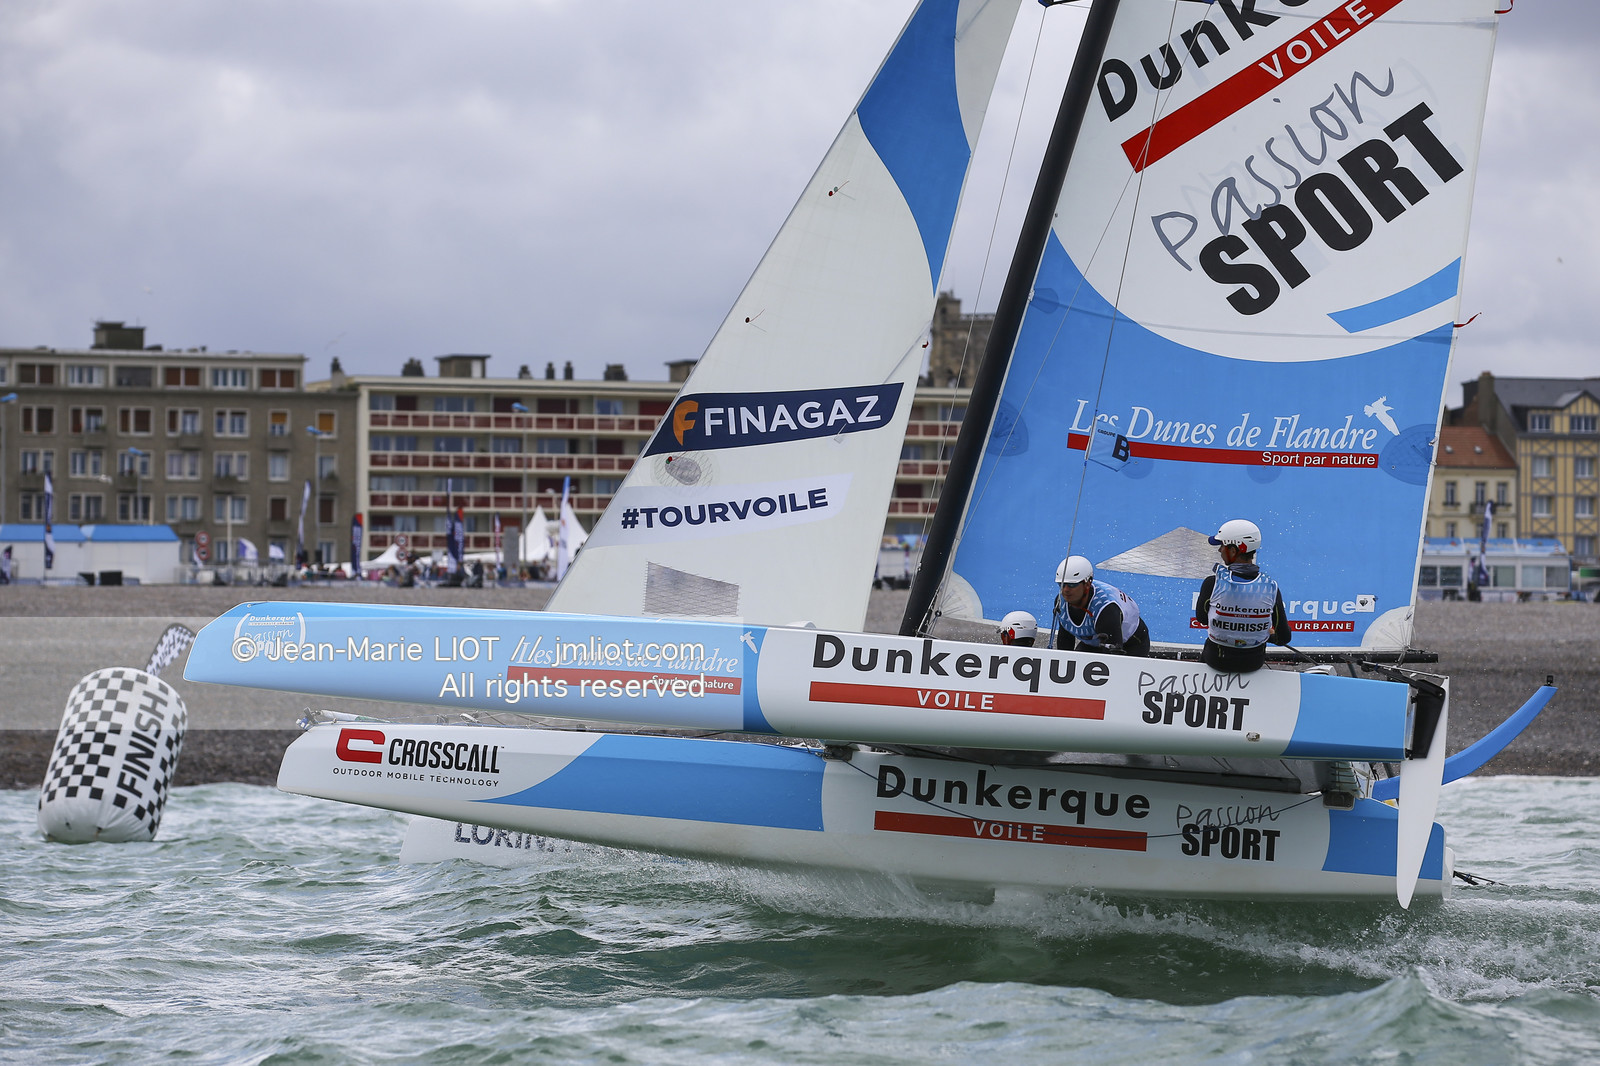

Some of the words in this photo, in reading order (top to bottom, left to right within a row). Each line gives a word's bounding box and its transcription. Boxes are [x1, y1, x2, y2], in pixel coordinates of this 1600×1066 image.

[1258, 0, 1374, 80] VOILE
[1097, 0, 1309, 122] Dunk
[1199, 101, 1465, 315] SPORT
[704, 395, 881, 436] FINAGAZ
[1126, 406, 1217, 445] Dunes
[1226, 413, 1261, 448] de
[1265, 413, 1378, 449] Flandre
[1112, 433, 1129, 462] B
[1262, 451, 1300, 466] Sport
[1304, 455, 1327, 467] par
[1331, 455, 1376, 465] nature
[621, 488, 829, 529] #TOURVOILE
[1212, 619, 1270, 632] MEURISSE
[1215, 602, 1272, 614] Dunkerque
[1294, 622, 1352, 631] URBAINE
[813, 634, 1110, 692] Dunkerque
[917, 690, 995, 711] VOILE
[1142, 690, 1250, 731] SPORT
[116, 690, 168, 799] FINISH
[333, 767, 382, 778] OUTDOOR
[387, 772, 424, 781] MOBILE
[430, 775, 499, 787] TECHNOLOGY
[876, 765, 1151, 824] Dunkerque
[973, 820, 1045, 842] VOILE
[1181, 824, 1280, 861] SPORT
